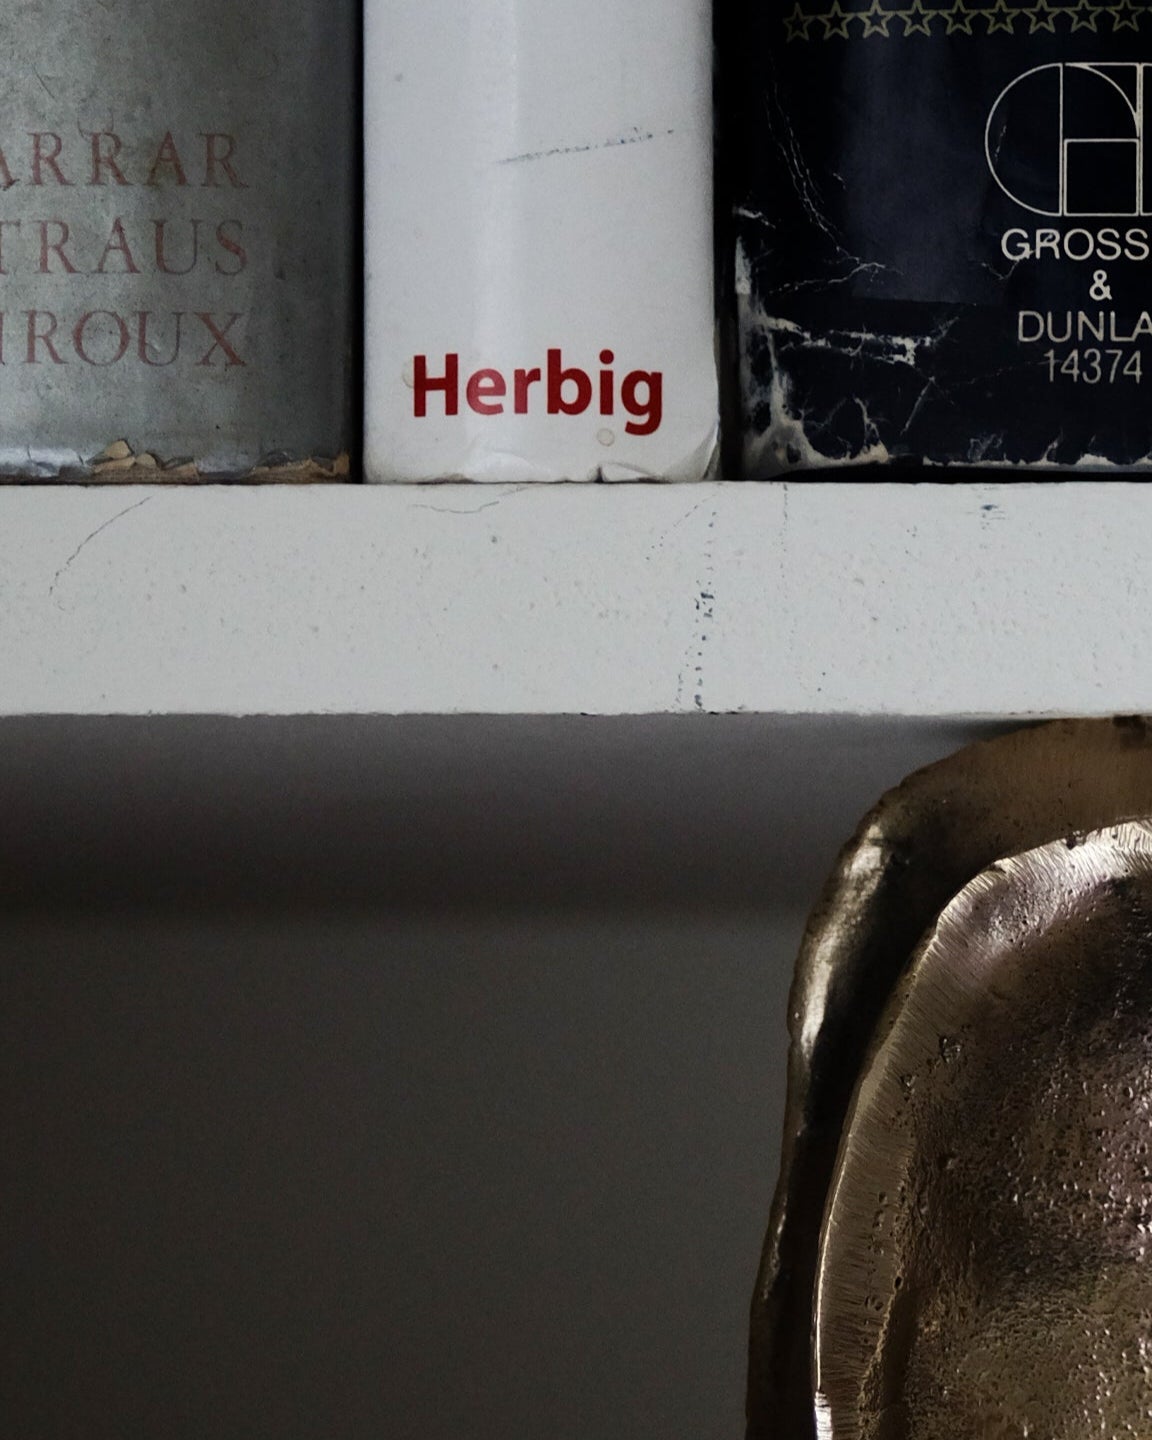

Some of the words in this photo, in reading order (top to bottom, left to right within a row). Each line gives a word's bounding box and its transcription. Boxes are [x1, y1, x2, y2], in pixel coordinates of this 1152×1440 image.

[1089, 269, 1112, 301] &
[1042, 348, 1143, 384] 14374
[413, 348, 663, 435] Herbig
